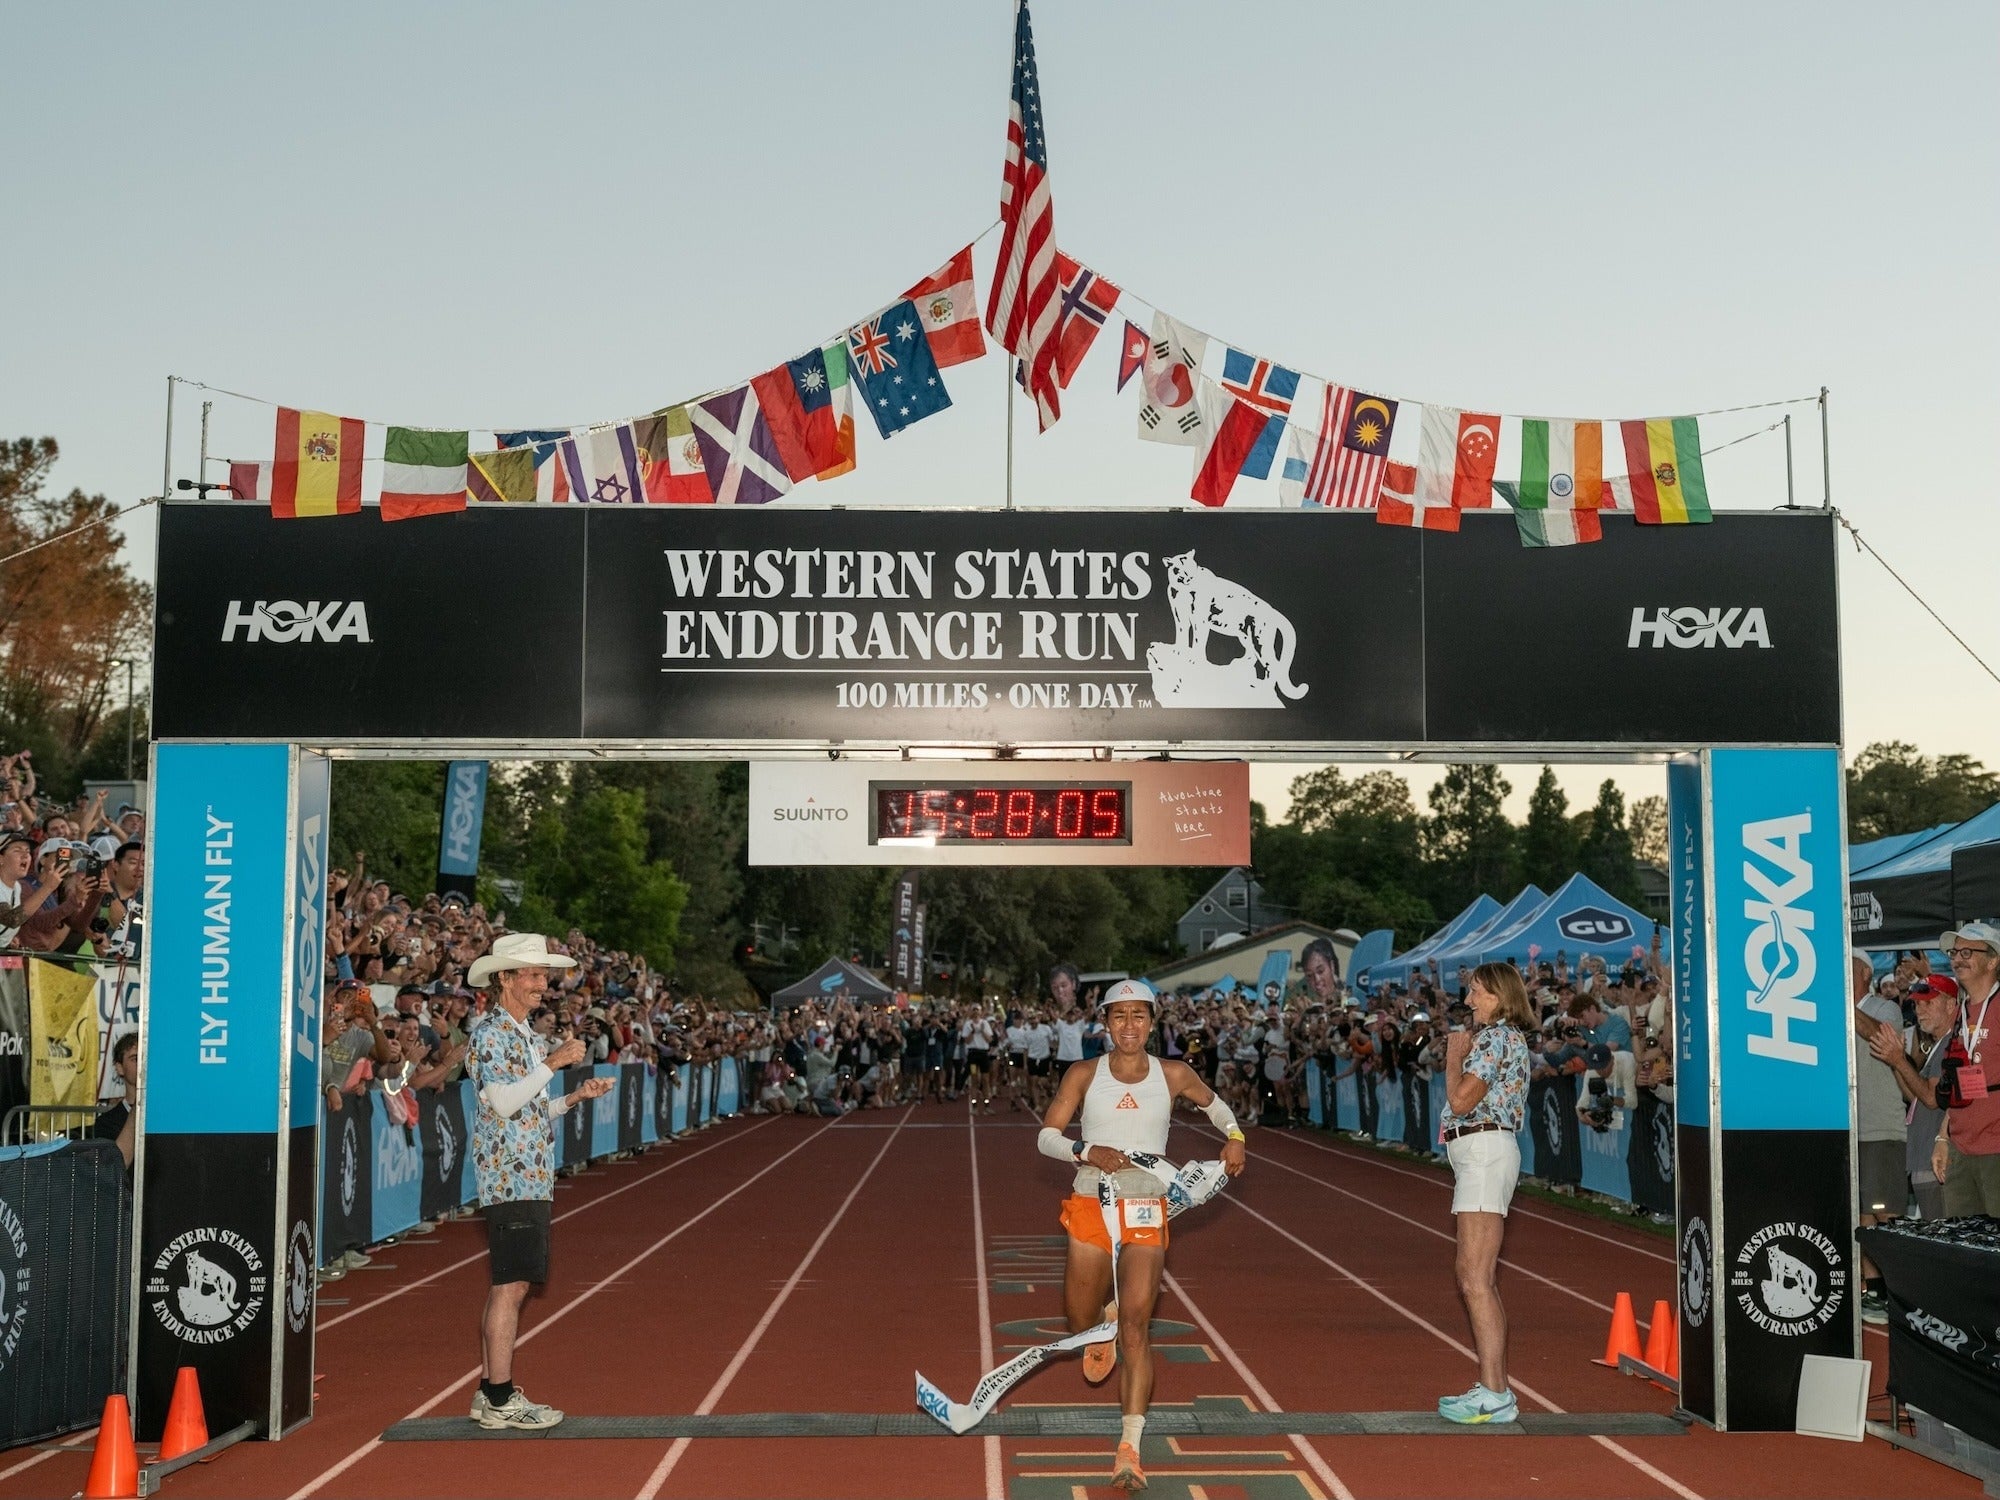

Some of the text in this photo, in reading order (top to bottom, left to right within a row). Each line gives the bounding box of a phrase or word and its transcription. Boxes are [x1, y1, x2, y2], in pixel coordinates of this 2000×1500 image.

[664, 547, 1152, 600] WESTERN STATES
[221, 599, 371, 643] HOKA
[661, 610, 1139, 661] ENDURANCE RUN
[1627, 606, 1771, 649] HOKA
[836, 681, 888, 708] 100
[892, 682, 989, 709] MILES
[1008, 682, 1071, 709] ONE
[1078, 682, 1139, 709] DAY
[447, 765, 480, 862] HOKA
[773, 807, 849, 821] SUUNTO
[204, 813, 235, 866] FLY
[901, 882, 912, 925] FLEET
[201, 875, 233, 1004] HUMAN
[297, 814, 321, 1062] HOKA
[1567, 920, 1625, 935] GU
[1682, 822, 1694, 1061] FLY HUMAN FLY
[1742, 812, 1819, 1066] HOKA
[200, 1011, 229, 1065] FLY
[0, 1198, 28, 1259] TATES
[1137, 1207, 1152, 1219] 21
[154, 1227, 218, 1271] WESTERN
[219, 1229, 263, 1272] STATES
[1737, 1222, 1841, 1265] WESTERN STATES
[17, 1267, 31, 1280] ONE
[17, 1280, 31, 1293] DAY
[146, 1285, 170, 1293] MILES
[150, 1277, 165, 1285] 100
[250, 1277, 266, 1285] ONE
[250, 1284, 266, 1293] DAY
[1731, 1278, 1753, 1286] MILES
[1829, 1270, 1846, 1278] ONE
[1830, 1278, 1845, 1286] DAY
[3, 1304, 27, 1358] RUN
[152, 1299, 235, 1345] ENDURANCE
[233, 1297, 263, 1331] RUN
[1737, 1290, 1843, 1337] ENDURANCE RUN
[918, 1382, 951, 1422] HOKA
